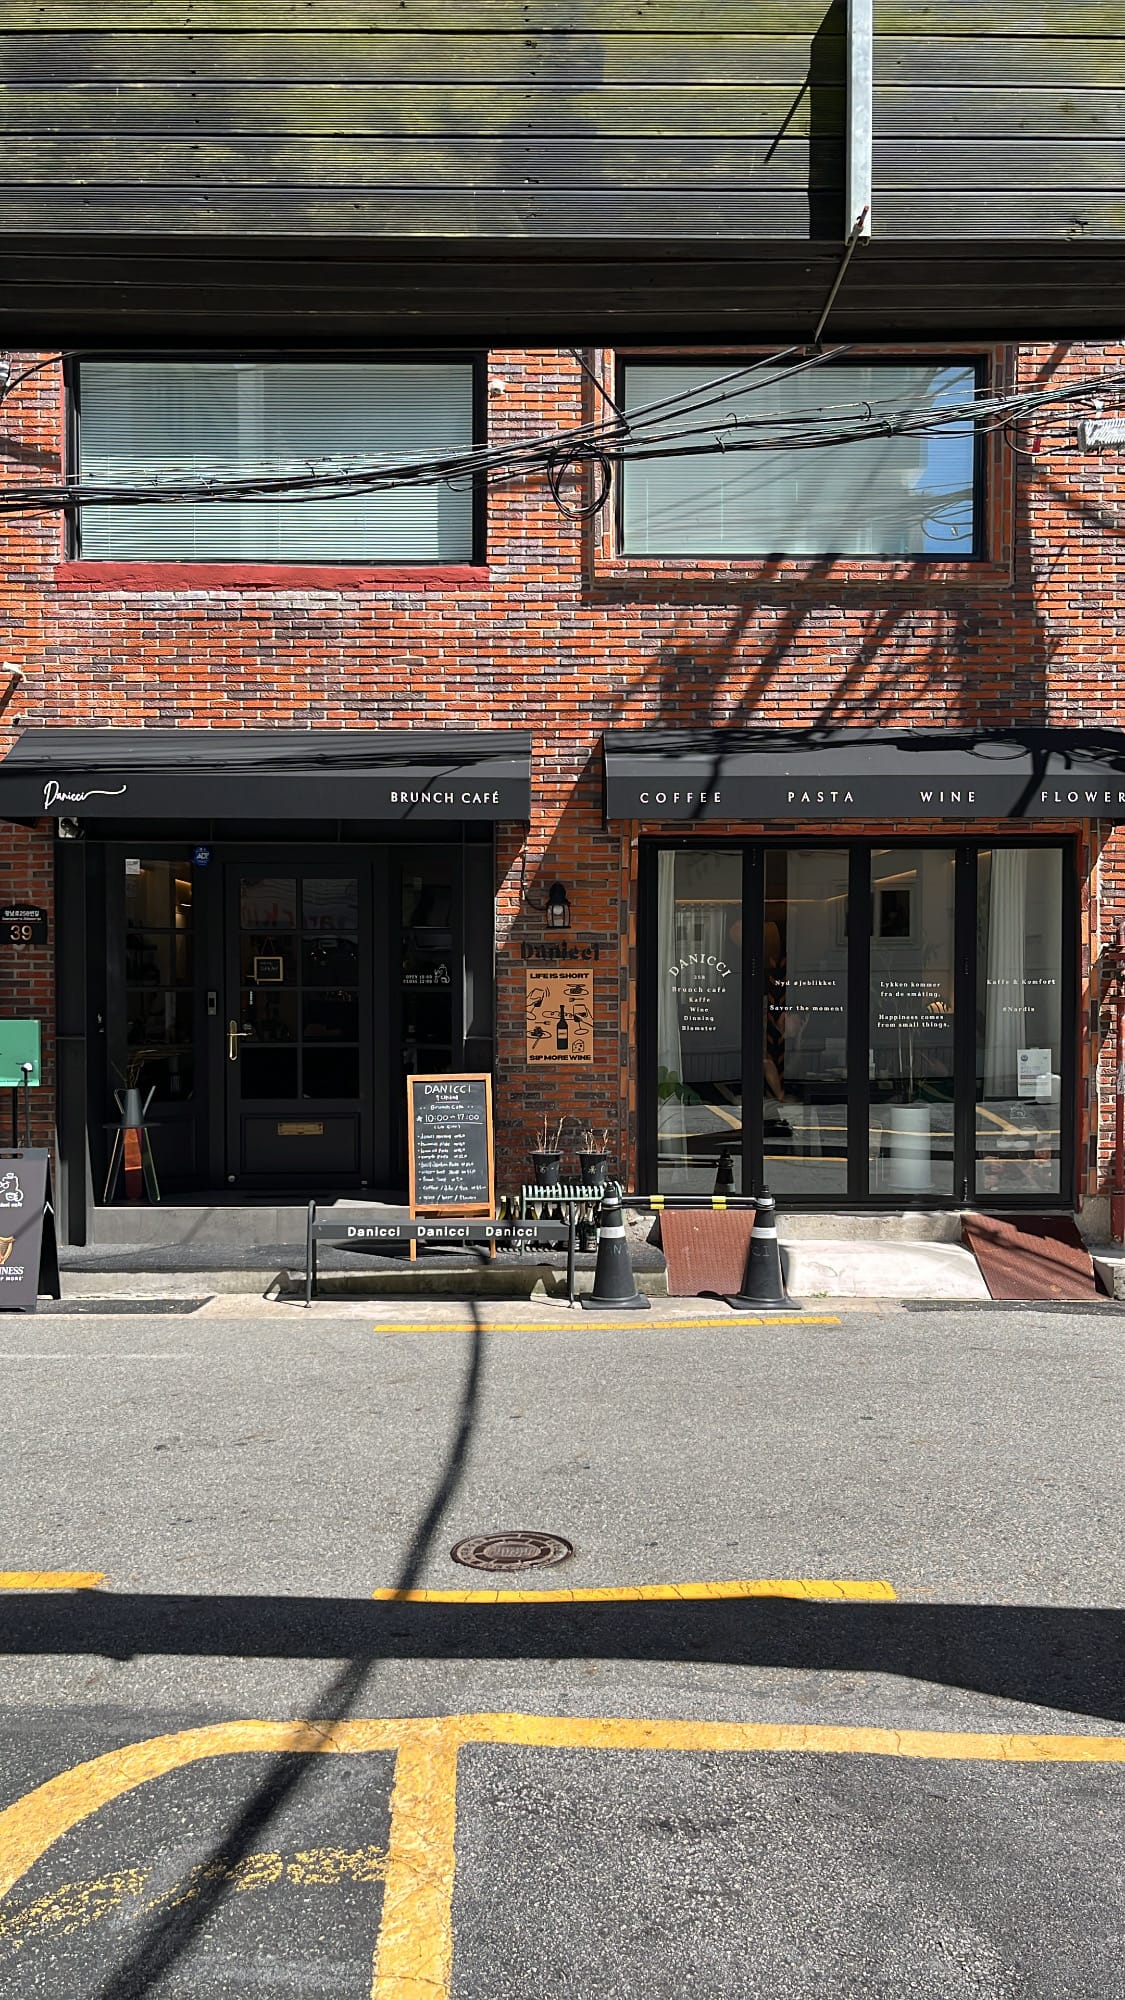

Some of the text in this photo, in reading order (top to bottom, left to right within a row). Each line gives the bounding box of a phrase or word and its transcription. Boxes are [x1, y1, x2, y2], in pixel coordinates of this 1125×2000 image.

[43, 780, 127, 810] Danicci
[390, 790, 500, 804] BRUNCH CAFÉ
[639, 792, 721, 804] COFFEE
[787, 791, 854, 803] PASTA
[920, 791, 976, 803] WINE
[10, 924, 33, 941] 39
[668, 953, 732, 978] DANICCI
[424, 1084, 471, 1095] DANICCI
[347, 1226, 401, 1237] Danicci
[417, 1226, 470, 1237] Danicci
[485, 1226, 538, 1237] Danicci
[0, 1266, 24, 1275] NESS
